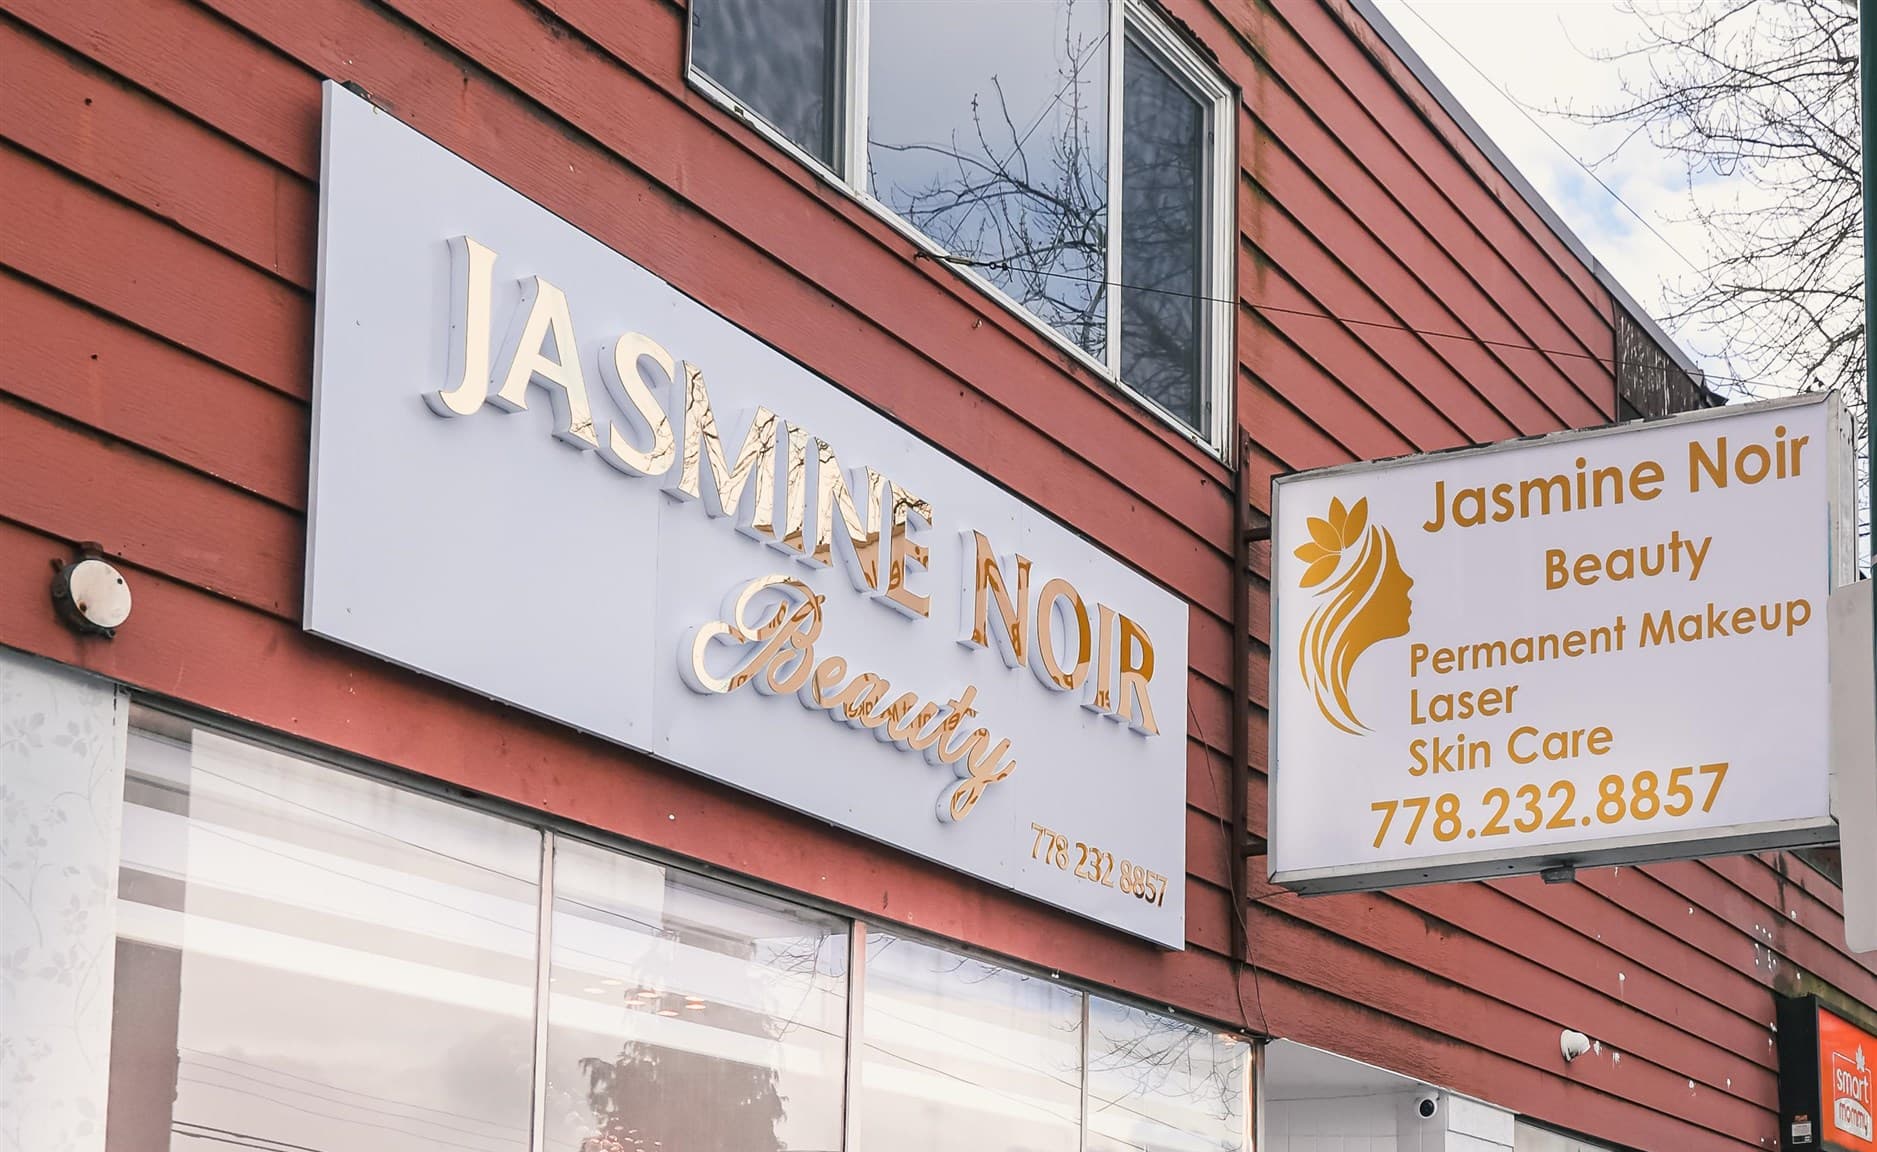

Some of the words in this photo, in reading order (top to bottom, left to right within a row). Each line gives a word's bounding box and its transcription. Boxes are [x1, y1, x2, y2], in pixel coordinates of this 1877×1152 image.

[422, 235, 933, 620] JASMINE
[956, 529, 1160, 738] NOIR
[1422, 457, 1665, 534] Jasmine
[1688, 425, 1810, 494] Noir
[1546, 530, 1713, 591] Beauty
[1410, 617, 1626, 678] Permanent
[1639, 596, 1812, 648] Makeup
[678, 573, 1017, 824] Beauty
[1410, 682, 1519, 726] Laser
[1408, 732, 1491, 778] Skin
[1507, 725, 1614, 766] Care
[1371, 762, 1730, 850] 778.232.8857
[1031, 822, 1070, 871] 778
[1074, 842, 1115, 888] 232
[1119, 859, 1168, 907] 8857
[1836, 1067, 1869, 1104] smart
[1839, 1102, 1869, 1137] mommy
